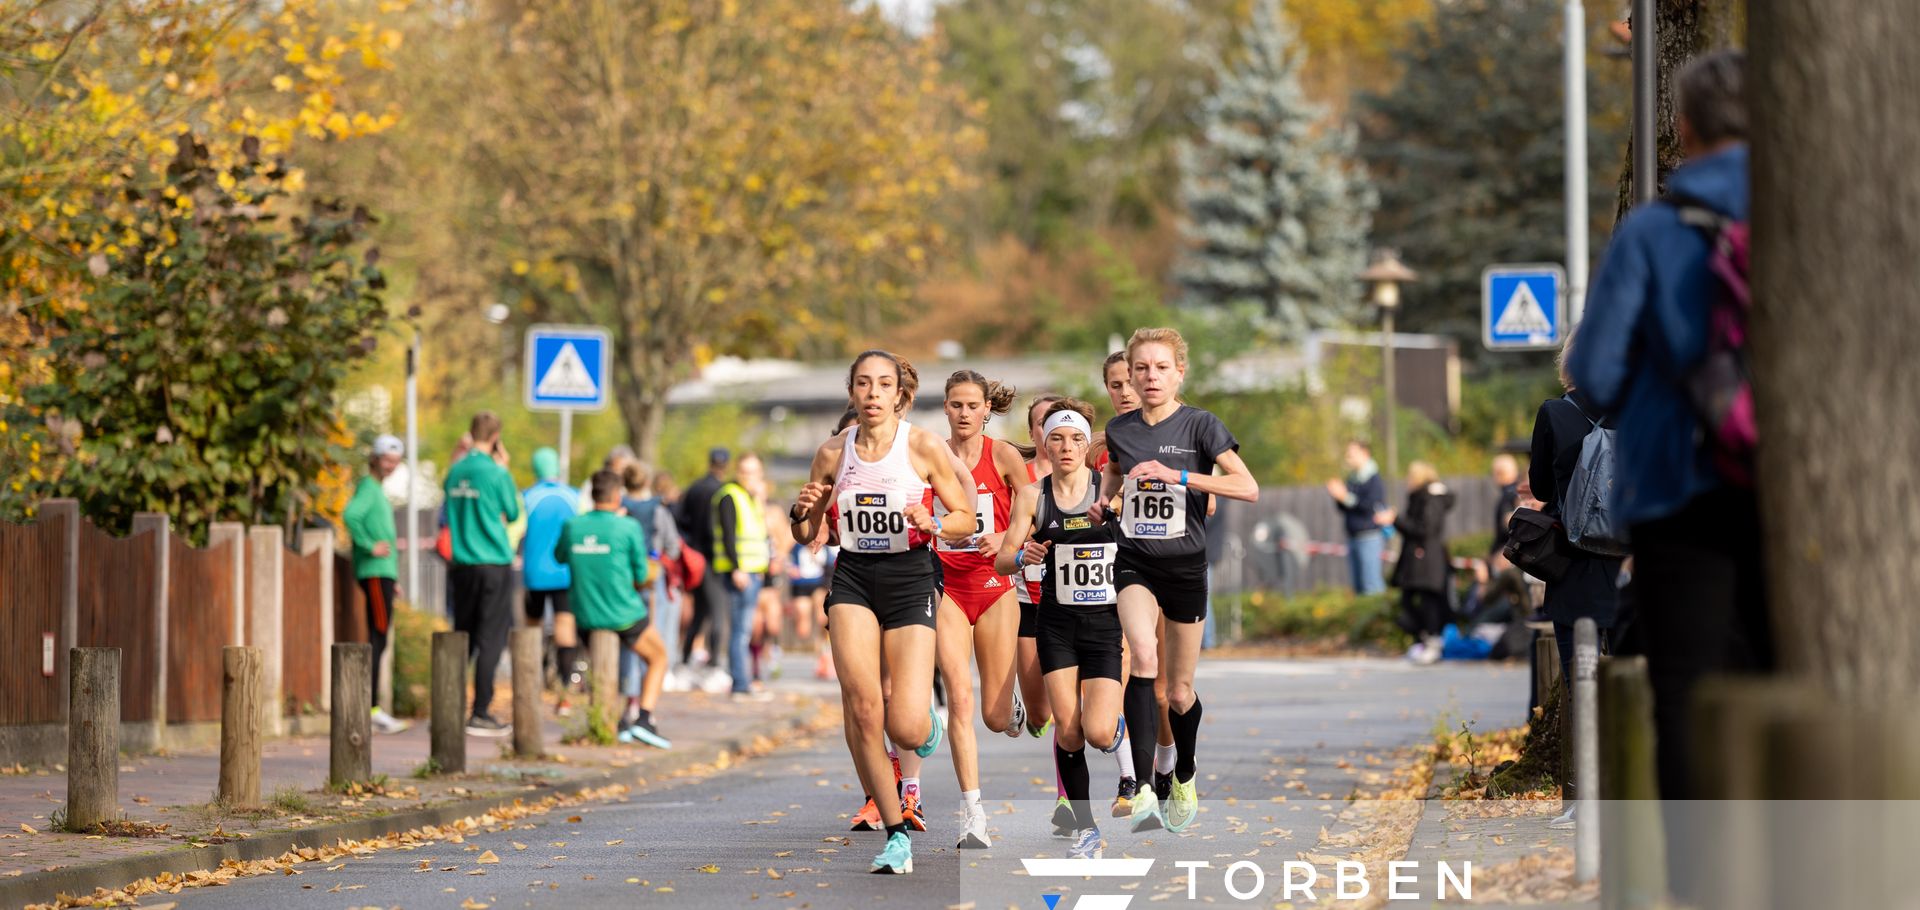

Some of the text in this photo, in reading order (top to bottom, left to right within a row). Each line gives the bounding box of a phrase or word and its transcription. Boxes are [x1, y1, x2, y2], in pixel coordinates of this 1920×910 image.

[1159, 446, 1176, 454] MIT
[1151, 482, 1164, 490] GLS
[872, 497, 885, 505] GLS
[1131, 496, 1174, 519] 166
[843, 510, 904, 534] 1080
[870, 539, 889, 547] PLAN
[1091, 550, 1103, 558] GLS
